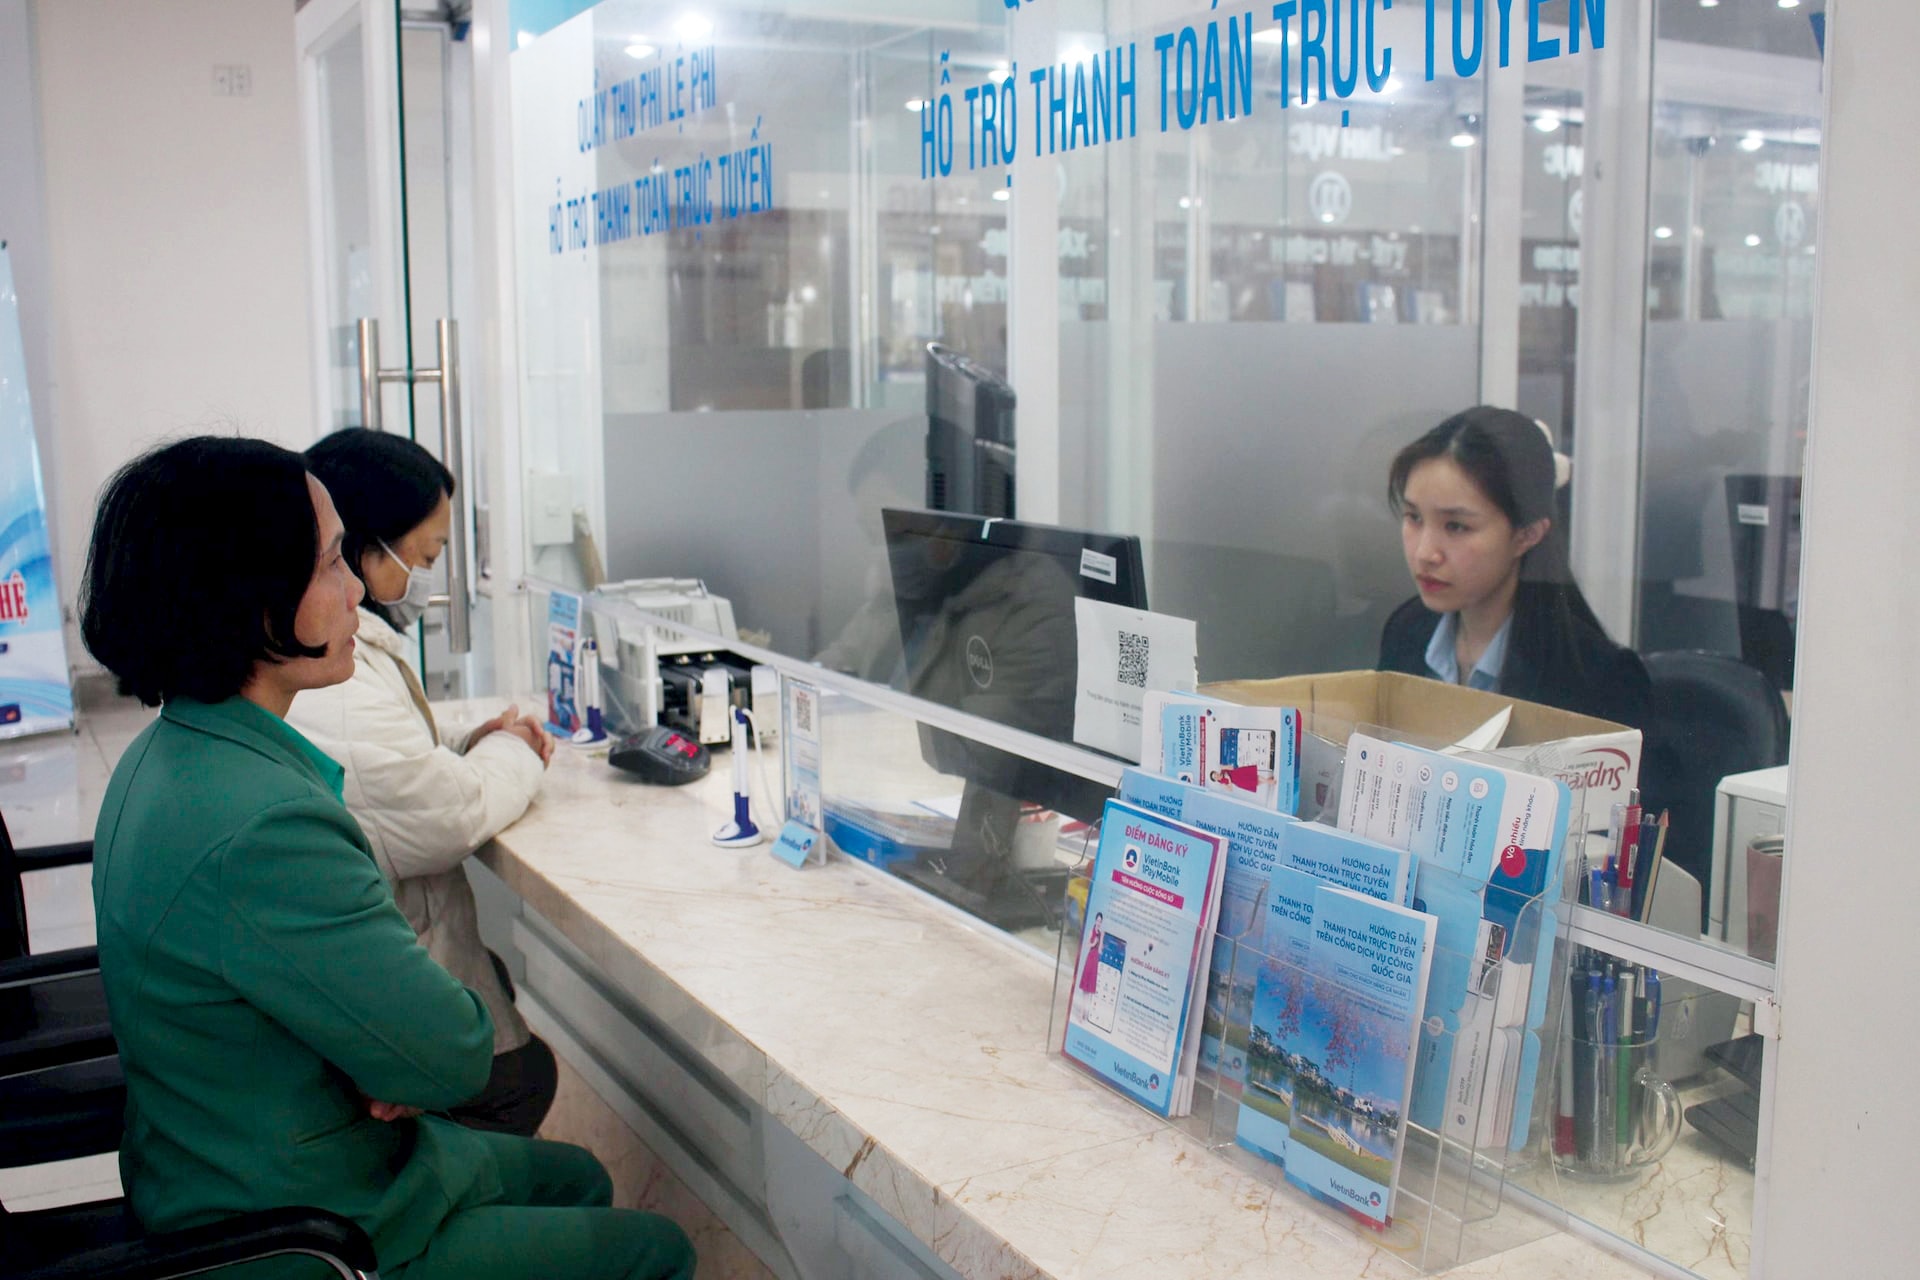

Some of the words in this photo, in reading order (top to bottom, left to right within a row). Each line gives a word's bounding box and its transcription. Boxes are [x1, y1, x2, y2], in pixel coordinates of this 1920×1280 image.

[921, 49, 952, 180] HỖ
[965, 62, 1017, 188] TRỢ
[1030, 43, 1136, 157] THANH
[1155, 0, 1252, 133] TOÁN
[611, 78, 636, 141] THU
[592, 184, 631, 245] THANH
[635, 157, 669, 236] TOÁN
[719, 115, 773, 220] TUYẾN
[1125, 824, 1147, 843] ĐIỂM
[1148, 832, 1173, 853] ĐĂNG
[1175, 843, 1188, 858] KÝ
[1195, 819, 1217, 833] THANH
[1217, 825, 1235, 838] TOÁN
[1237, 832, 1254, 845] TRỰC
[1255, 838, 1278, 851] TUYẾN
[1238, 820, 1263, 834] HƯỚNG
[1263, 828, 1279, 840] DẪN
[1144, 853, 1181, 876] VietinBank
[1238, 855, 1259, 869] QUỐC
[1253, 848, 1276, 862] CÔNG
[1341, 856, 1371, 872] HƯỚNG
[1372, 863, 1390, 877] DẪN
[1292, 854, 1316, 868] THANH
[1318, 861, 1339, 875] TOÁN
[1341, 868, 1362, 882] TRỰC
[1363, 872, 1389, 889] TUYẾN
[1271, 904, 1289, 917] TRÊN
[1289, 910, 1311, 925] CỔNG
[1278, 895, 1301, 908] THANH
[1303, 903, 1314, 914] TO
[1323, 919, 1346, 935] THANH
[1348, 927, 1367, 942] TOÁN
[1368, 935, 1388, 951] TRỰC
[1389, 943, 1415, 959] TUYẾN
[1369, 922, 1397, 940] HƯỚNG
[1398, 932, 1417, 946] DẪN
[1316, 929, 1333, 943] TRÊN
[1334, 936, 1356, 952] CỔNG
[1357, 945, 1375, 958] DỊCH
[1376, 952, 1386, 965] VỤ
[1387, 956, 1413, 972] CÔNG
[1371, 962, 1394, 979] QUỐC
[1395, 972, 1412, 984] GIA
[1113, 1061, 1149, 1090] VietinBank
[1329, 1177, 1370, 1207] VietinBank
